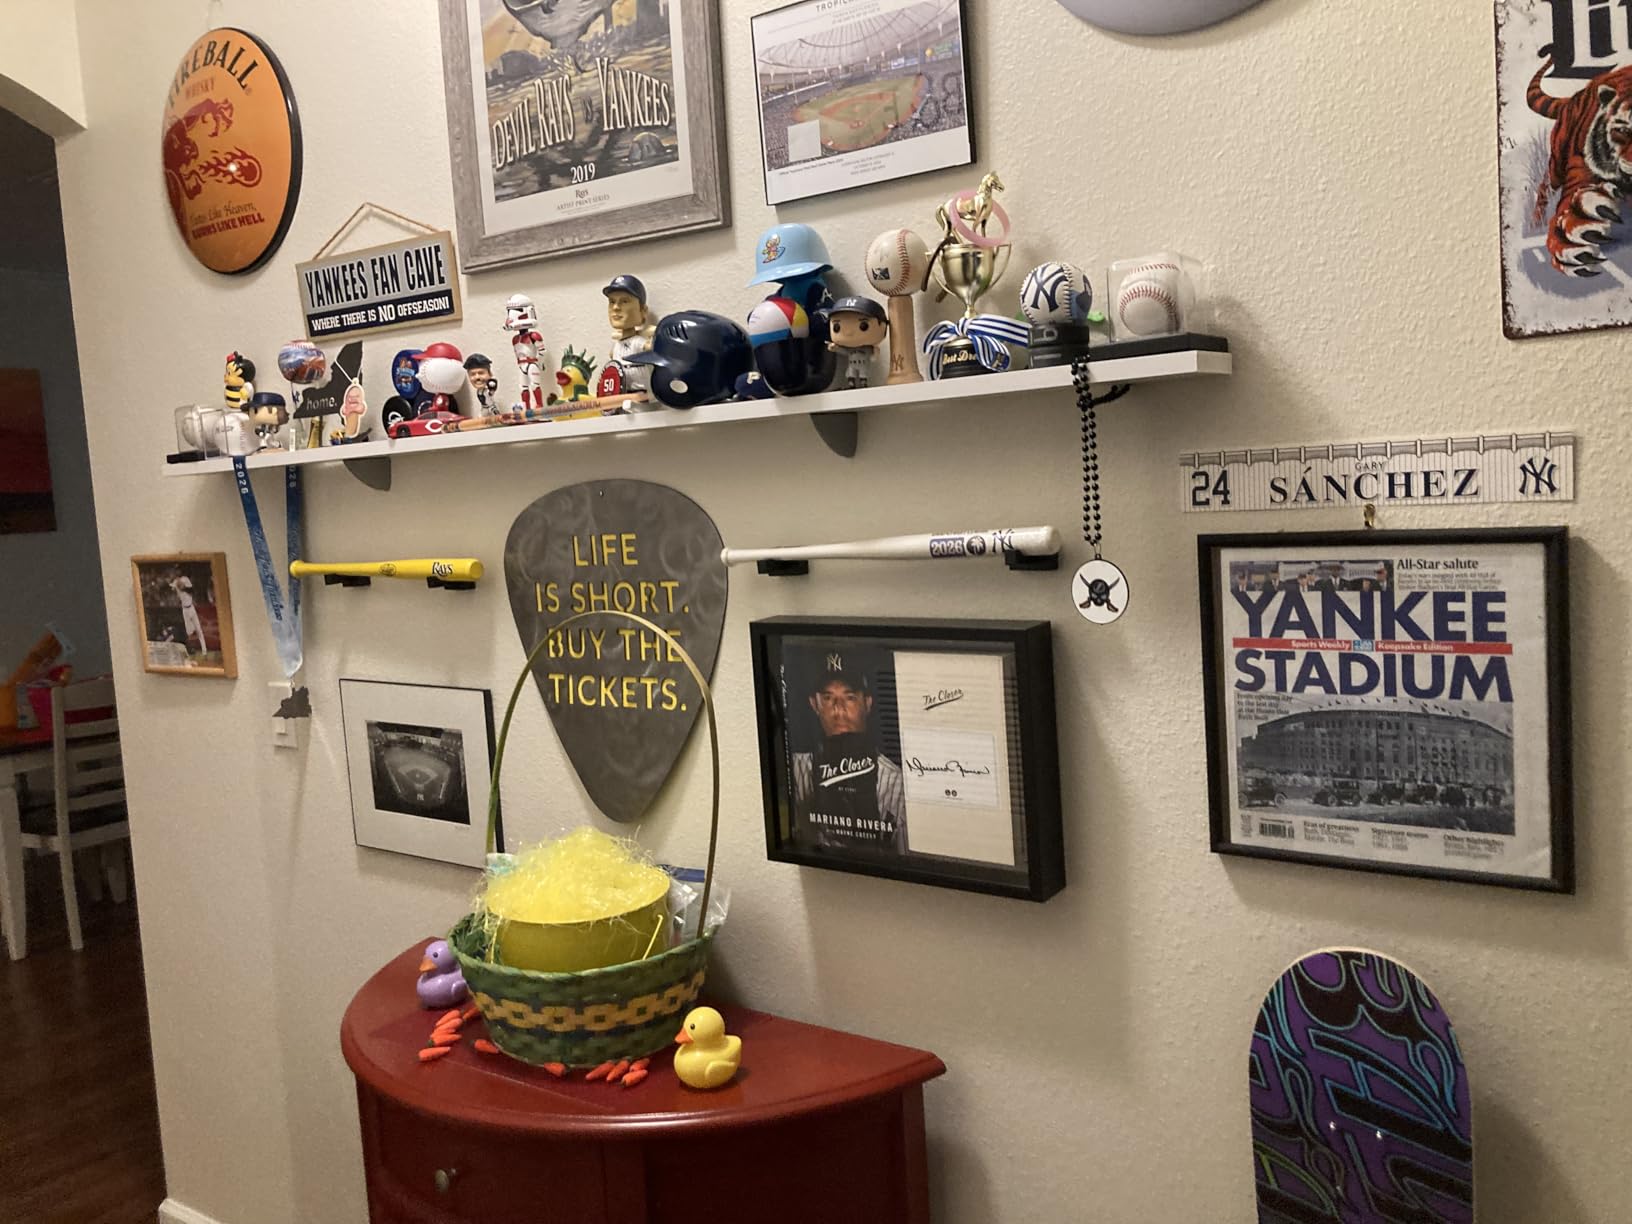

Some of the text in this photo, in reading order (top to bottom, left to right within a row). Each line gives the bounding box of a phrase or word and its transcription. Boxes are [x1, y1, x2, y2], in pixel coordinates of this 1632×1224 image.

[492, 97, 536, 169] DEVIL
[534, 74, 575, 149] RAYS
[596, 57, 671, 131] YANKEES
[571, 162, 596, 184] 2019
[238, 212, 264, 227] HELL
[305, 245, 446, 308] YANKEES FAN CAVE
[311, 296, 450, 331] WHERE THERE IS NO OFFSEASON!
[603, 379, 615, 392] 50
[306, 396, 338, 411] home.
[1355, 461, 1386, 472] GARY
[1191, 456, 1558, 506] 24 SÁNCHEZ NY
[572, 533, 639, 567] LIFE
[930, 540, 964, 556] 2026
[1397, 558, 1479, 570] All-Star salute
[535, 581, 690, 614] IS SHORT.
[1231, 591, 1507, 642] YANKEE
[547, 628, 685, 663] BUY THE
[1291, 640, 1317, 650] Sports
[1318, 640, 1350, 650] Weekly
[1378, 642, 1422, 652] Keepsake
[1423, 643, 1454, 652] Edition
[826, 653, 843, 672] NY
[1234, 649, 1514, 703] STADIUM
[548, 673, 688, 712] TICKETS.
[923, 688, 963, 705] The Closer
[819, 756, 873, 779] The Closer
[809, 812, 894, 833] MARIANO RIVERA
